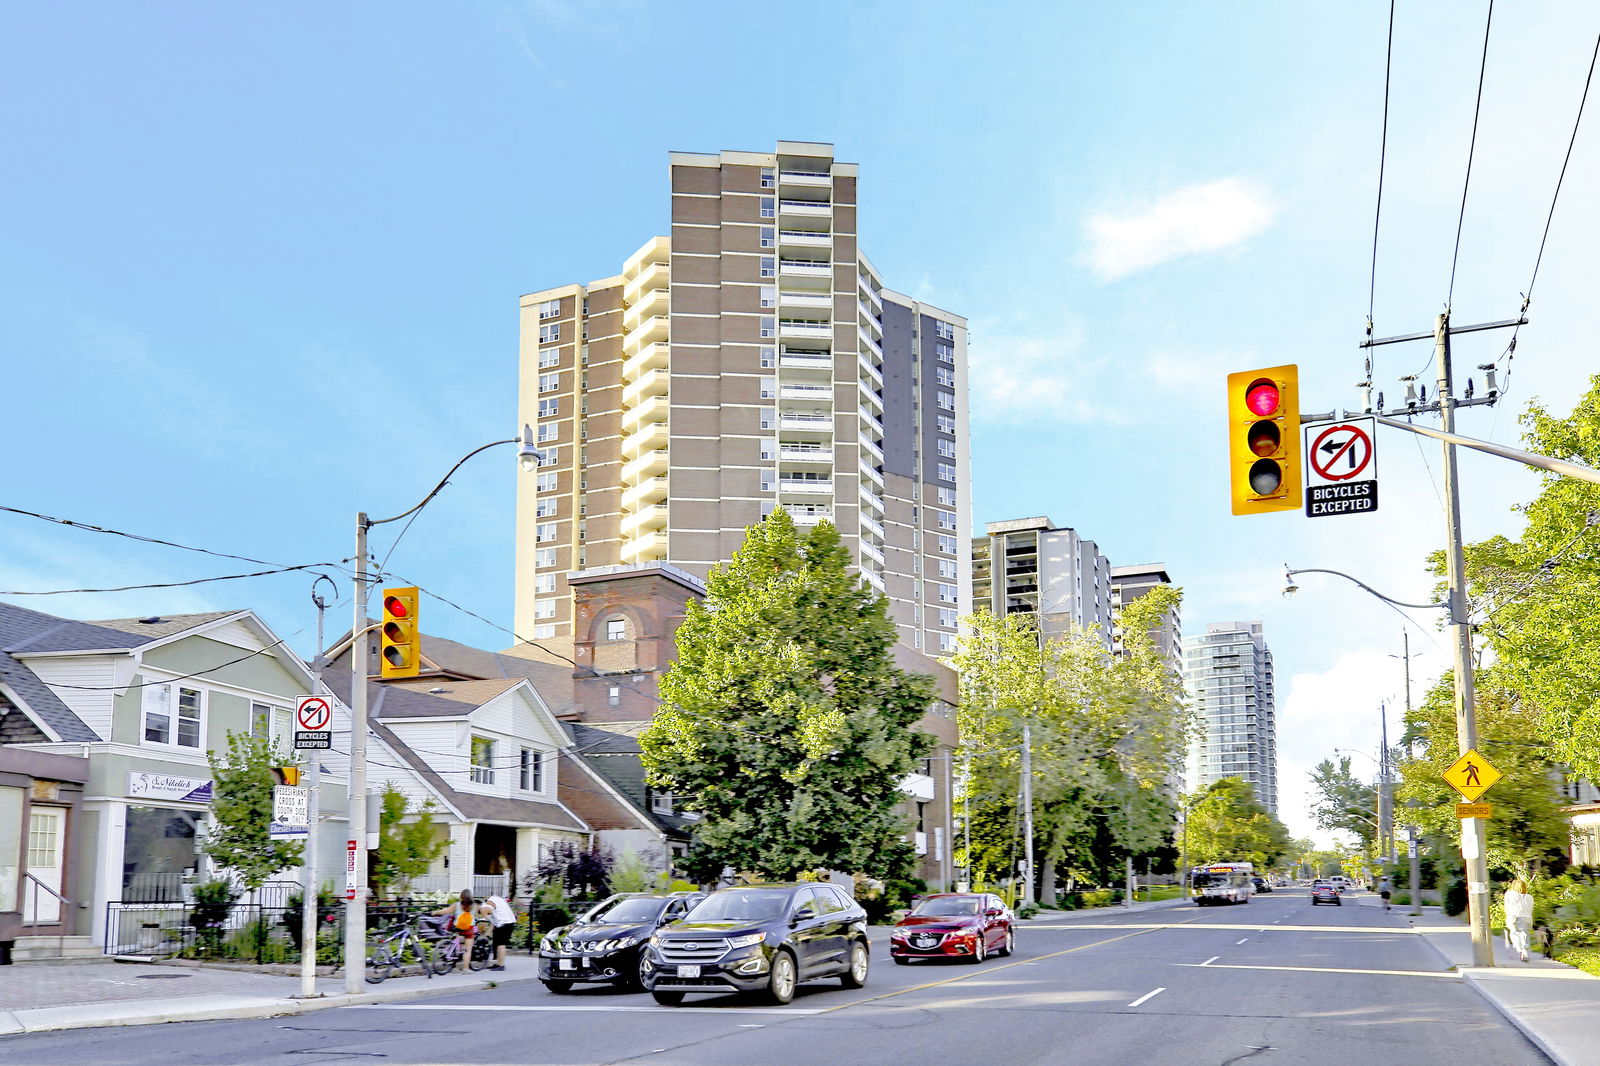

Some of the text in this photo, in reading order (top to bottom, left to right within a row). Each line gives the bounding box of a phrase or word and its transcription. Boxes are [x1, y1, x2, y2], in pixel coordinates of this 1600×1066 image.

[1313, 484, 1370, 500] BICYCLES
[1312, 498, 1372, 514] EXCEPTED
[297, 740, 328, 748] EXCEPTED
[279, 797, 304, 807] CROSS AT
[1458, 806, 1489, 815] SENIORS
